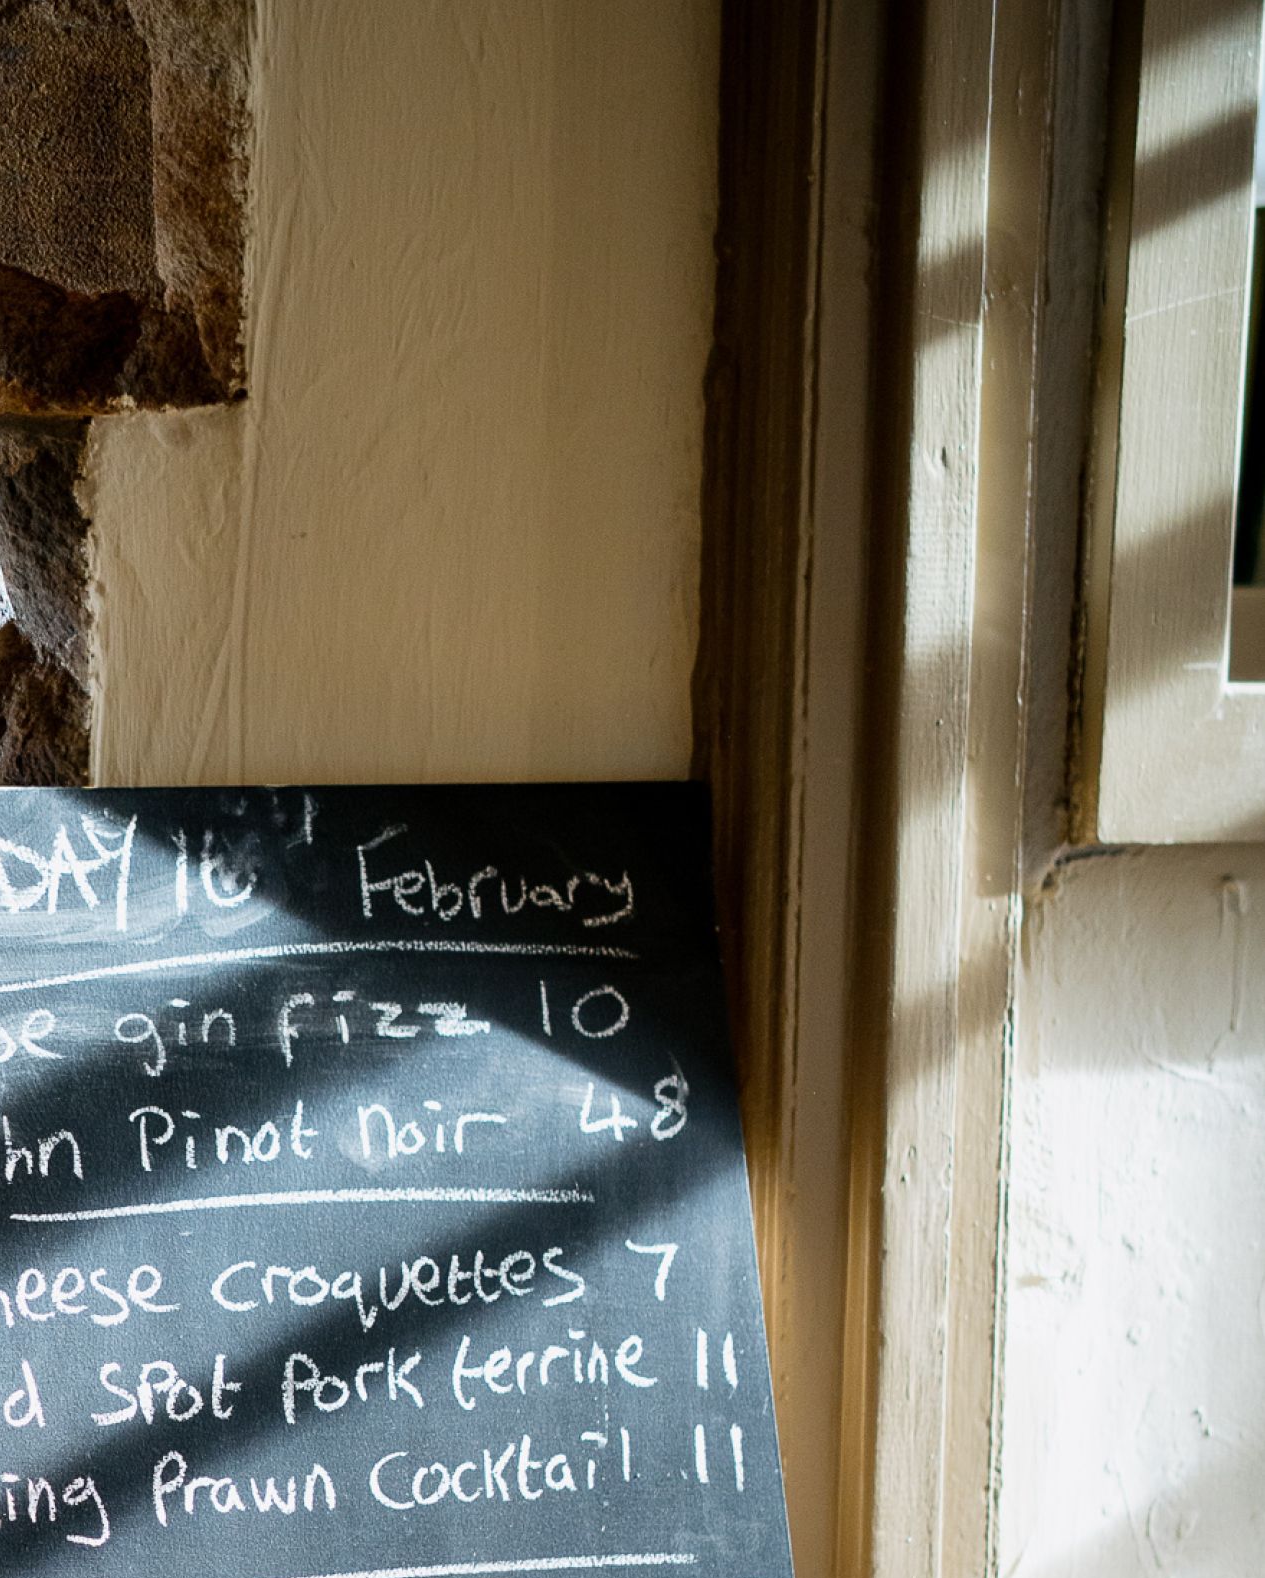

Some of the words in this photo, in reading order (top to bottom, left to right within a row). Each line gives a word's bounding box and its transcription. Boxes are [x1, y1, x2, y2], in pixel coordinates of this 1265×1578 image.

[356, 824, 636, 928] February
[115, 999, 238, 1077] gin
[278, 990, 491, 1066] fizz
[540, 981, 631, 1039] 10
[130, 1101, 317, 1172] Pinot
[578, 1074, 689, 1143] 48
[625, 1241, 680, 1301] 7
[451, 1328, 645, 1411] terrine
[695, 1327, 739, 1391] 11
[694, 1423, 745, 1493] 11
